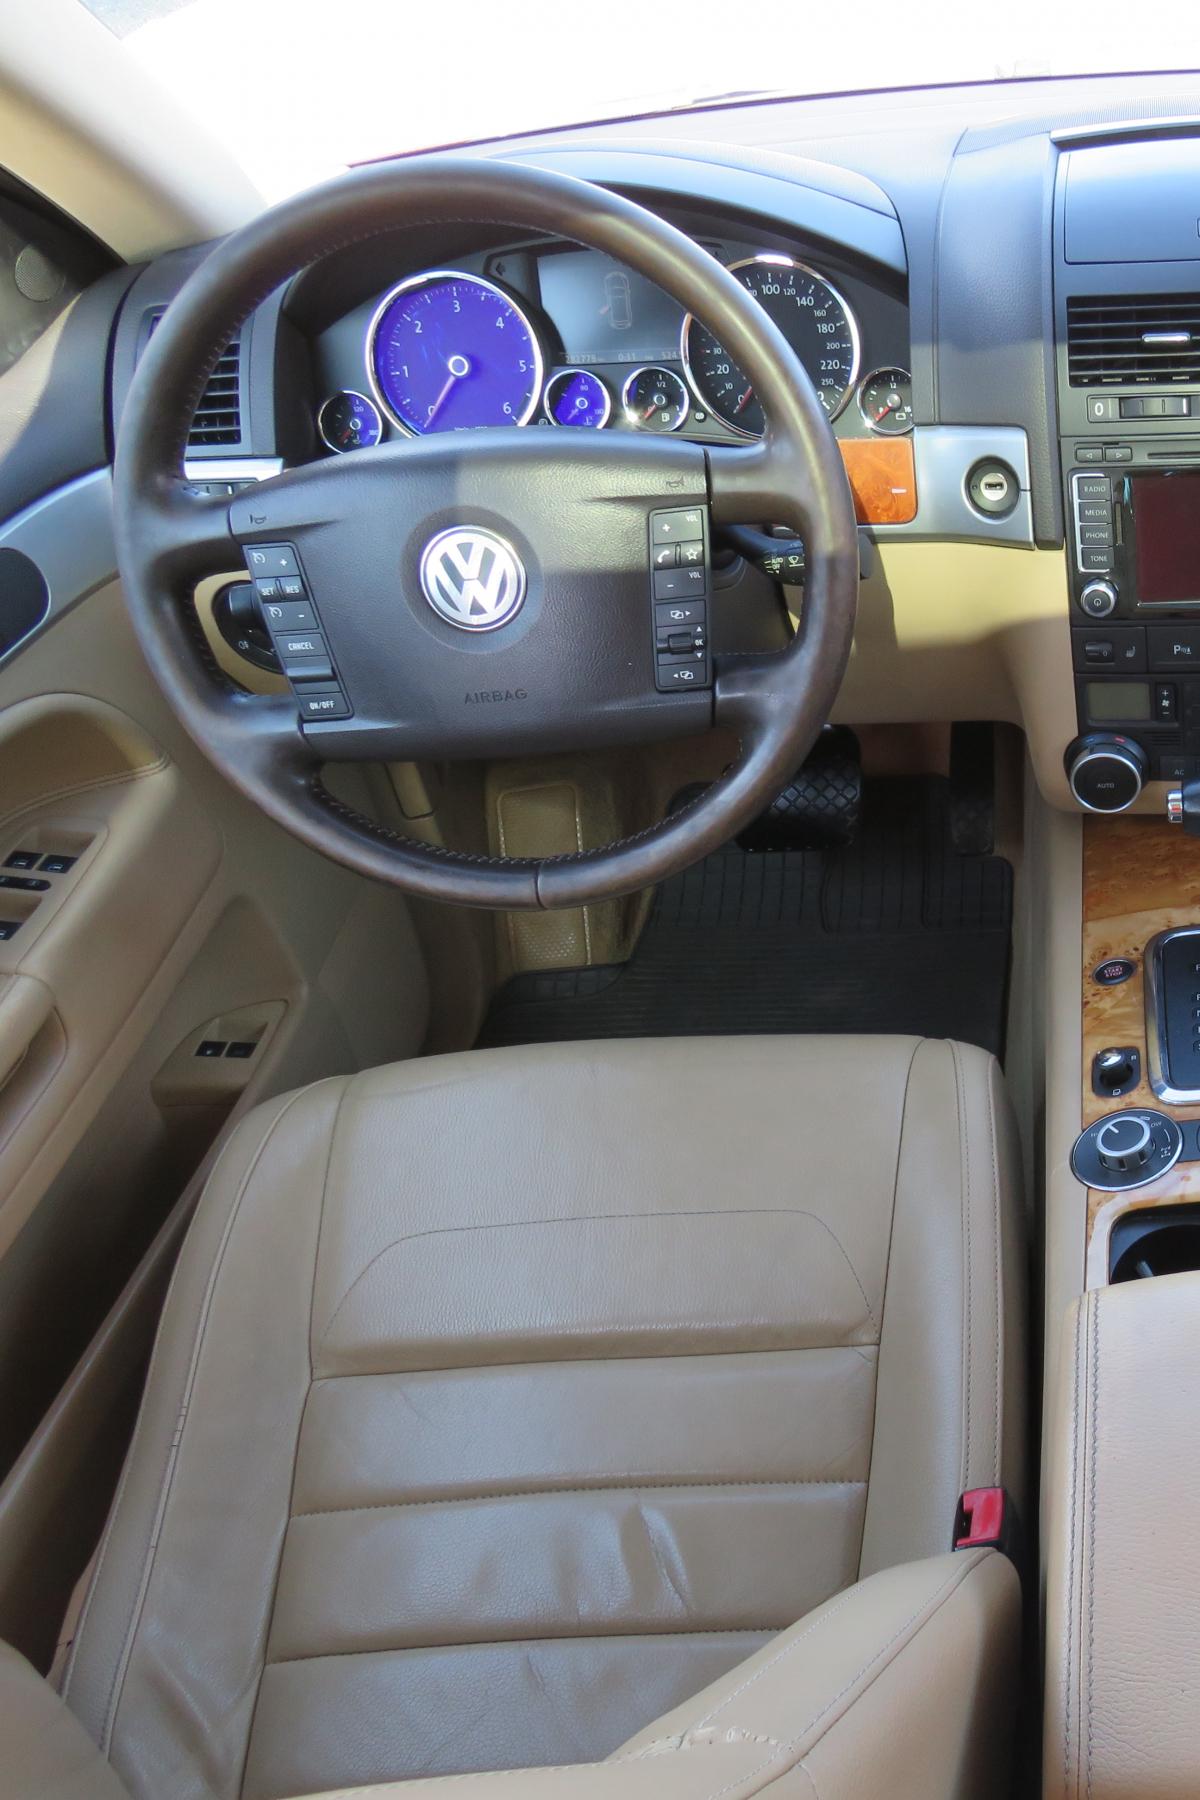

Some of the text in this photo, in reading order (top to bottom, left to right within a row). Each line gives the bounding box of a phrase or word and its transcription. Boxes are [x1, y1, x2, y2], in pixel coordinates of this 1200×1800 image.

[761, 284, 780, 295] 100
[783, 288, 796, 296] 120
[453, 300, 461, 313] 3
[796, 296, 815, 307] 140
[814, 309, 827, 317] 160
[414, 321, 423, 334] 2
[496, 317, 505, 329] 4
[817, 323, 836, 334] 180
[826, 342, 840, 350] 200
[519, 361, 527, 373] 5
[716, 364, 730, 375] 20
[820, 359, 840, 370] 220
[403, 366, 409, 378] 1
[725, 382, 734, 390] 10
[503, 402, 512, 415] 6
[689, 571, 701, 579] VOL
[288, 642, 314, 651] CANCEL
[464, 688, 529, 705] AIRBAG
[310, 701, 335, 710] ON/OFF
